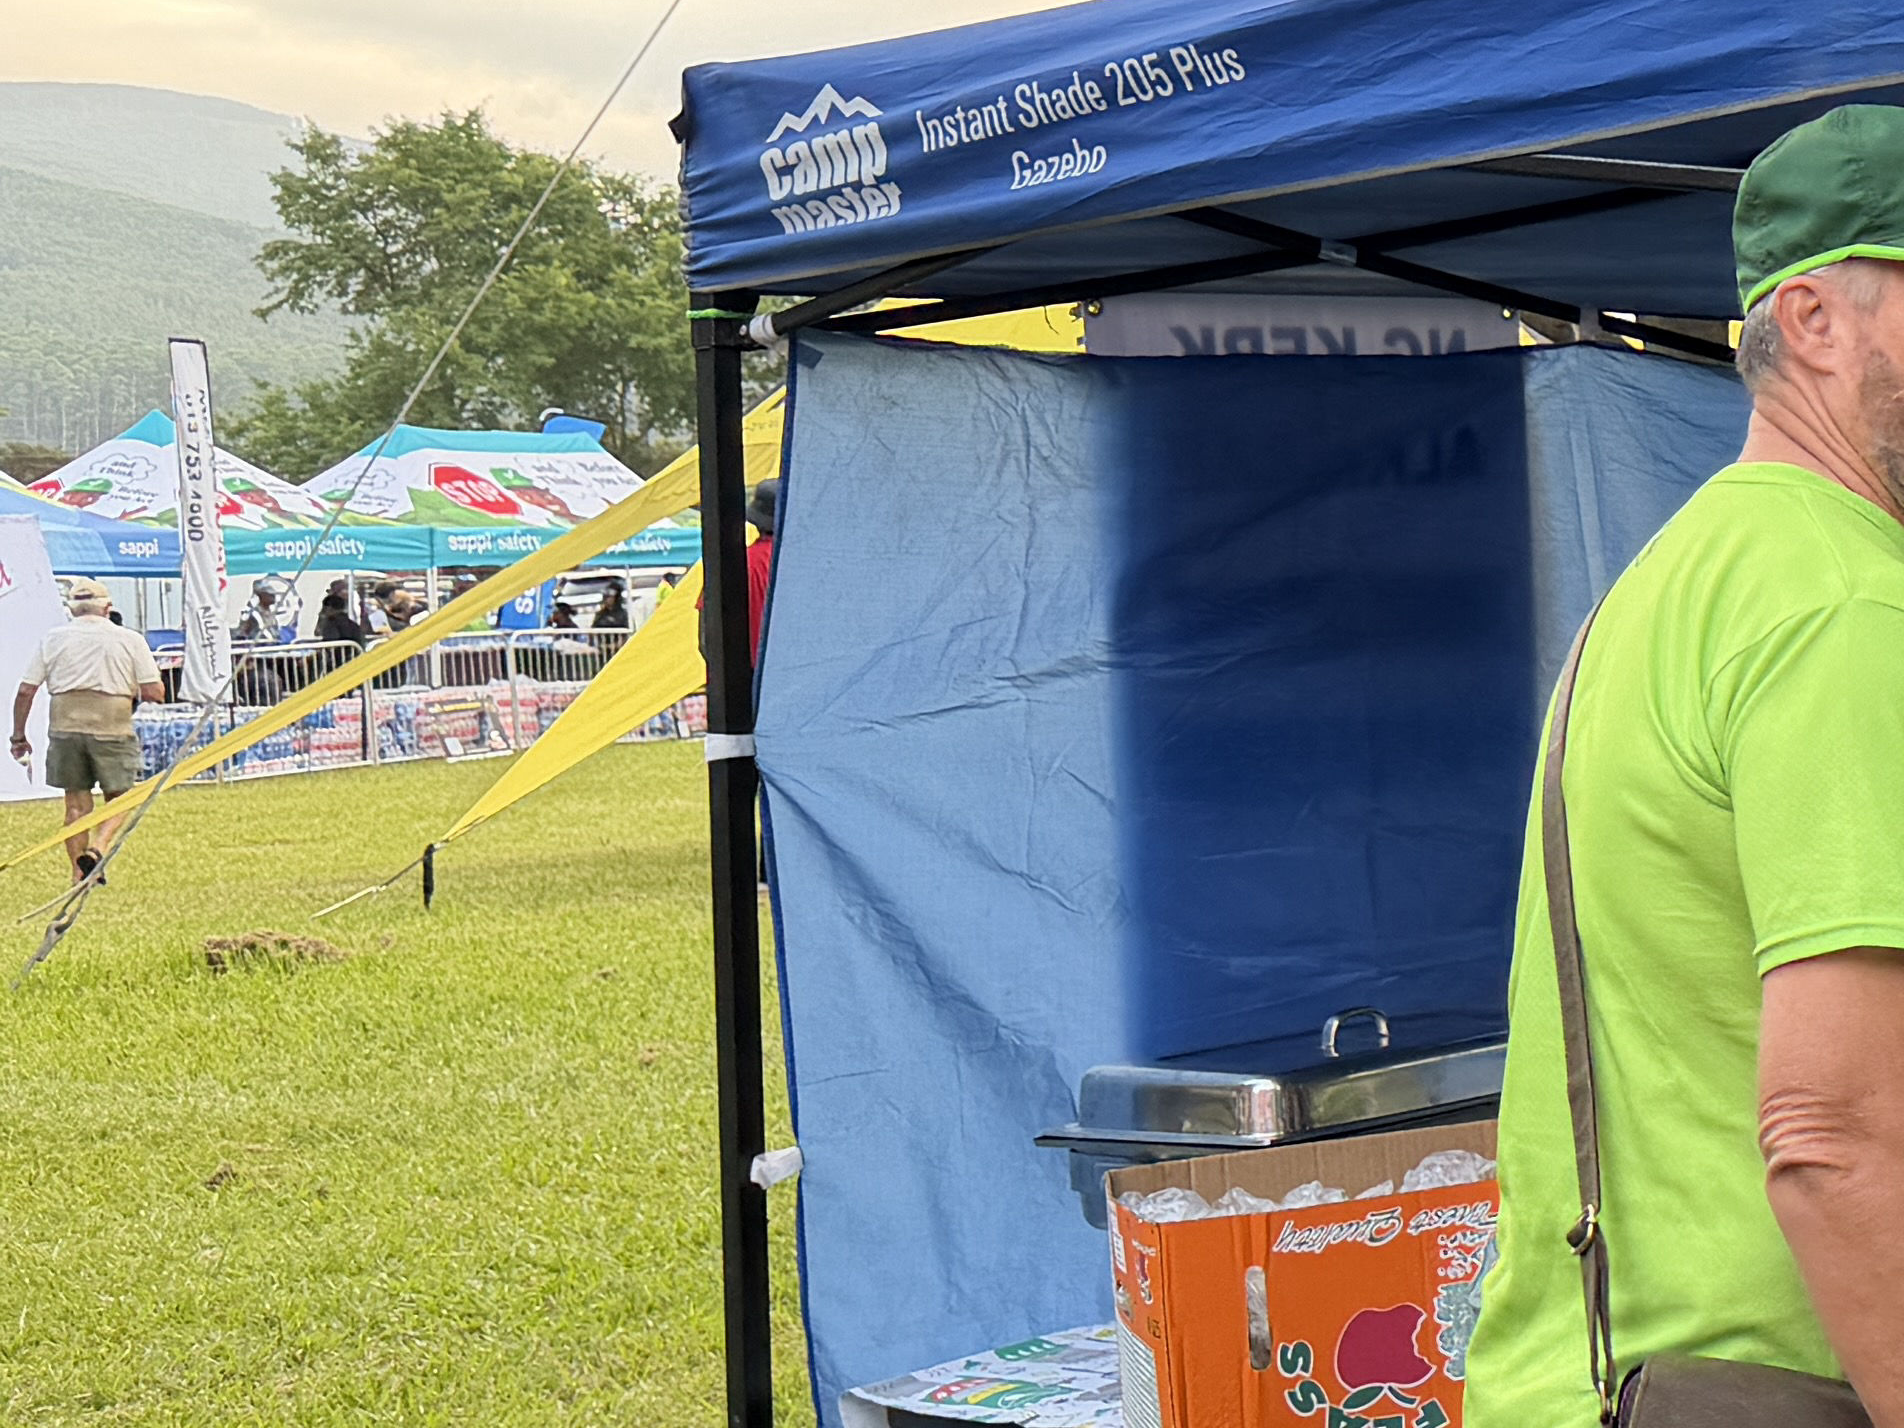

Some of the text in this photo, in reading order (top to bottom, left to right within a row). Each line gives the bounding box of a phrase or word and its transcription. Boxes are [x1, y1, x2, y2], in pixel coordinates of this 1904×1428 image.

[915, 44, 1246, 152] Instant Shade 205 Plus
[760, 122, 887, 201] camp
[1010, 138, 1107, 190] Gazebo
[771, 182, 902, 236] master
[441, 479, 506, 504] STOP
[118, 538, 159, 565] sappi
[263, 535, 366, 561] sappi safety
[448, 530, 542, 553] sappi safety
[1272, 1207, 1403, 1254] Quality
